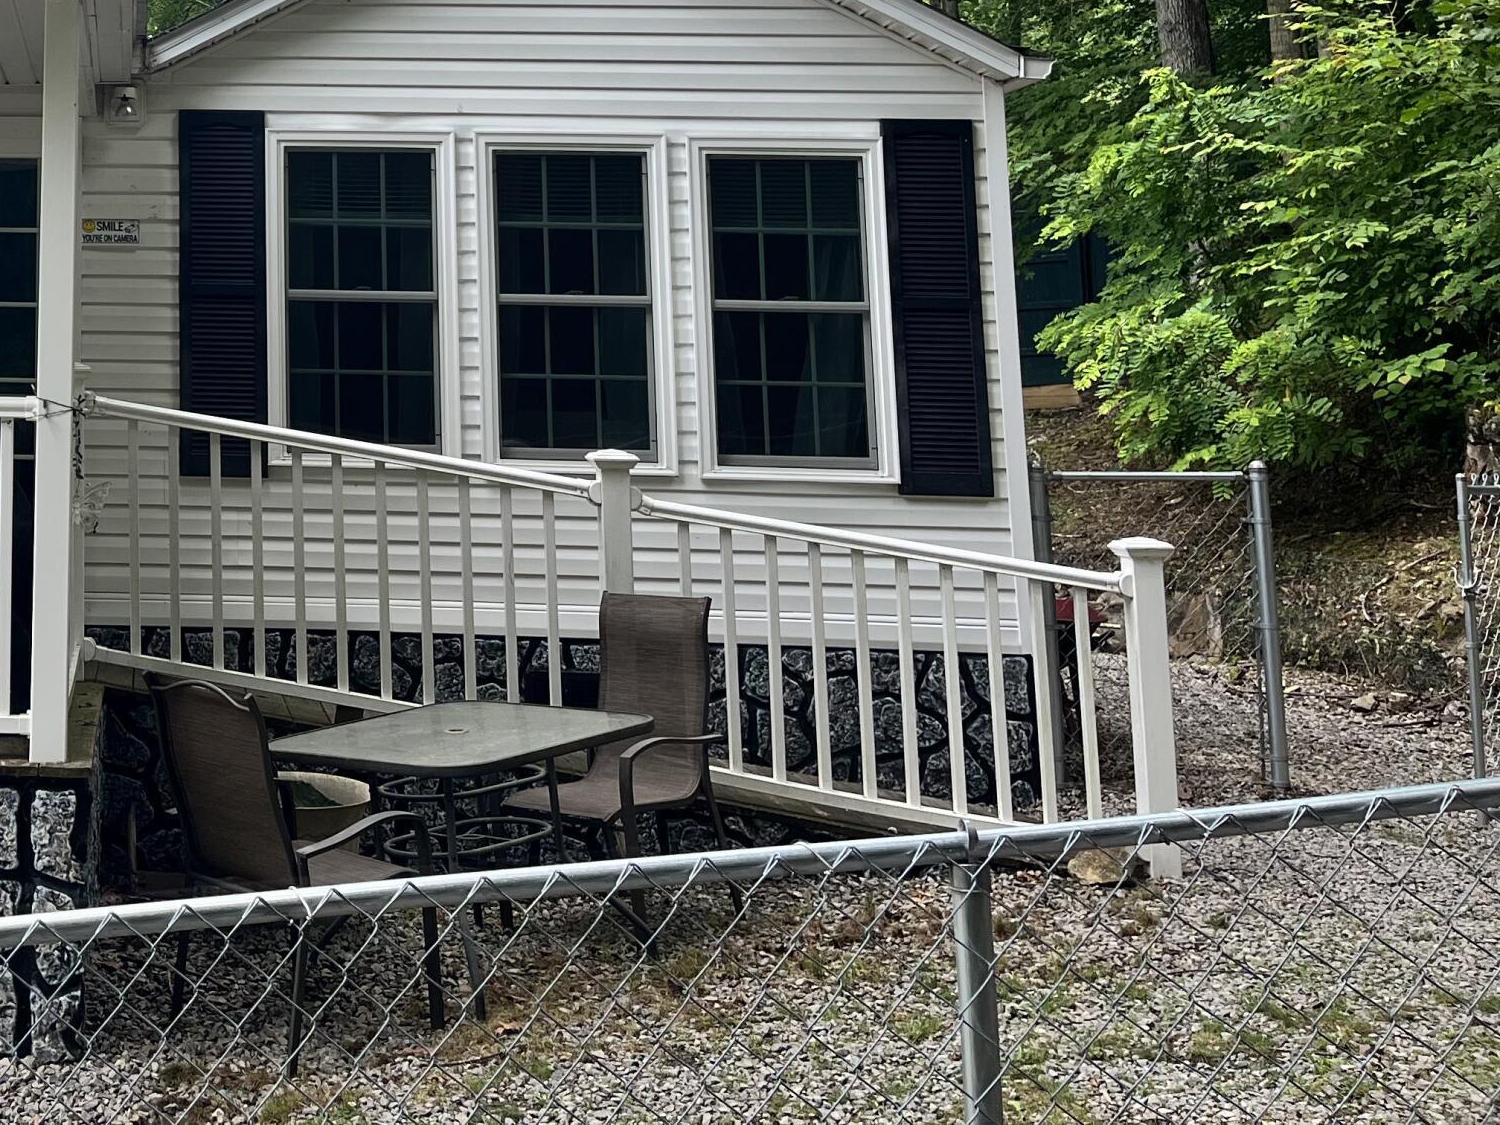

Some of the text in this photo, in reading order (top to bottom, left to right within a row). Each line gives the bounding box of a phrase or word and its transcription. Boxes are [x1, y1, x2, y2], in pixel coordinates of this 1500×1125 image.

[96, 221, 124, 231] SMILE
[82, 234, 138, 242] YOU'RE ON CAMERA
